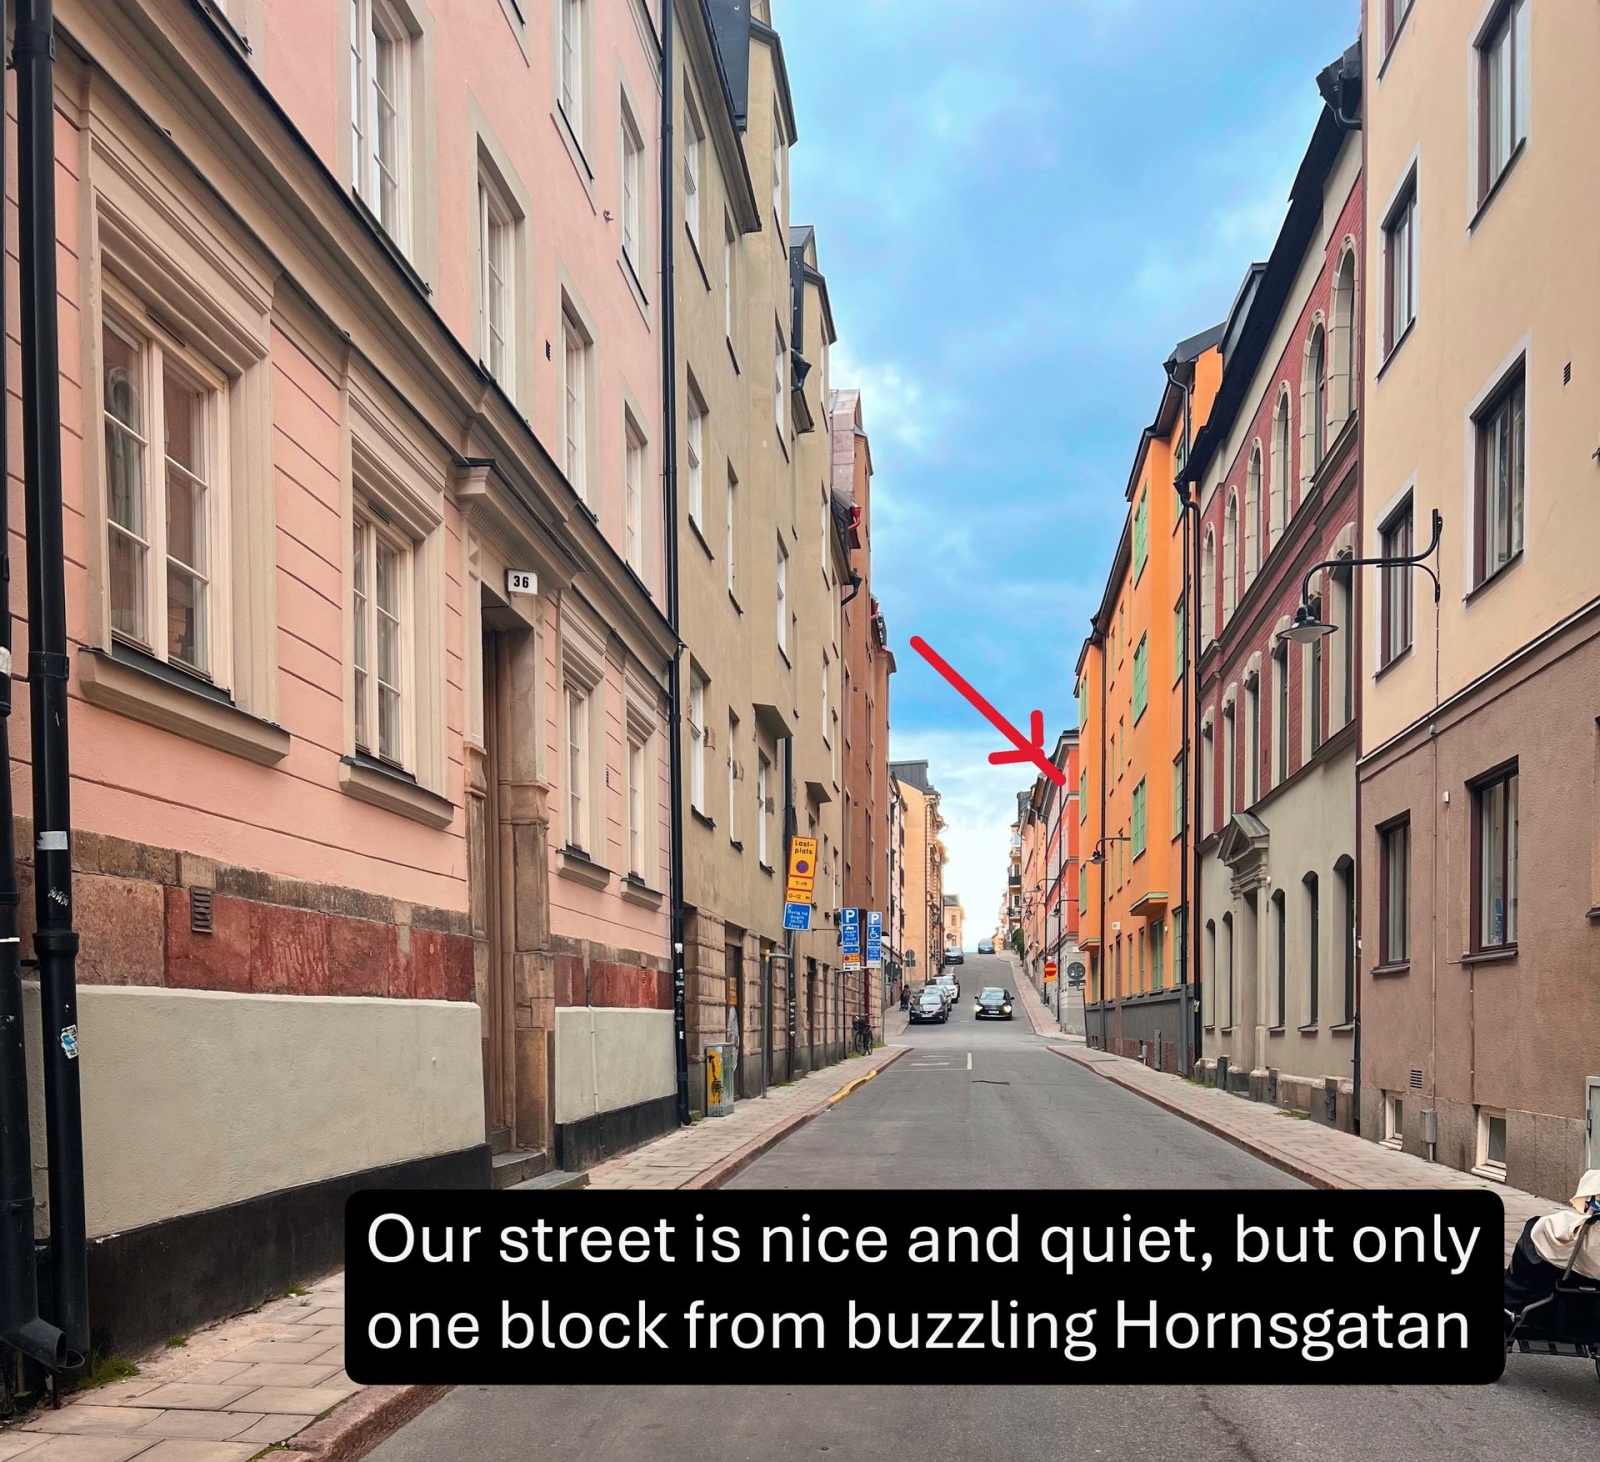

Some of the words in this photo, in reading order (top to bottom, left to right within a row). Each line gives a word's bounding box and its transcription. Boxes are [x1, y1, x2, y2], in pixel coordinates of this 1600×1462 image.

[513, 575, 529, 588] 36
[845, 909, 856, 923] P
[871, 913, 880, 925] P
